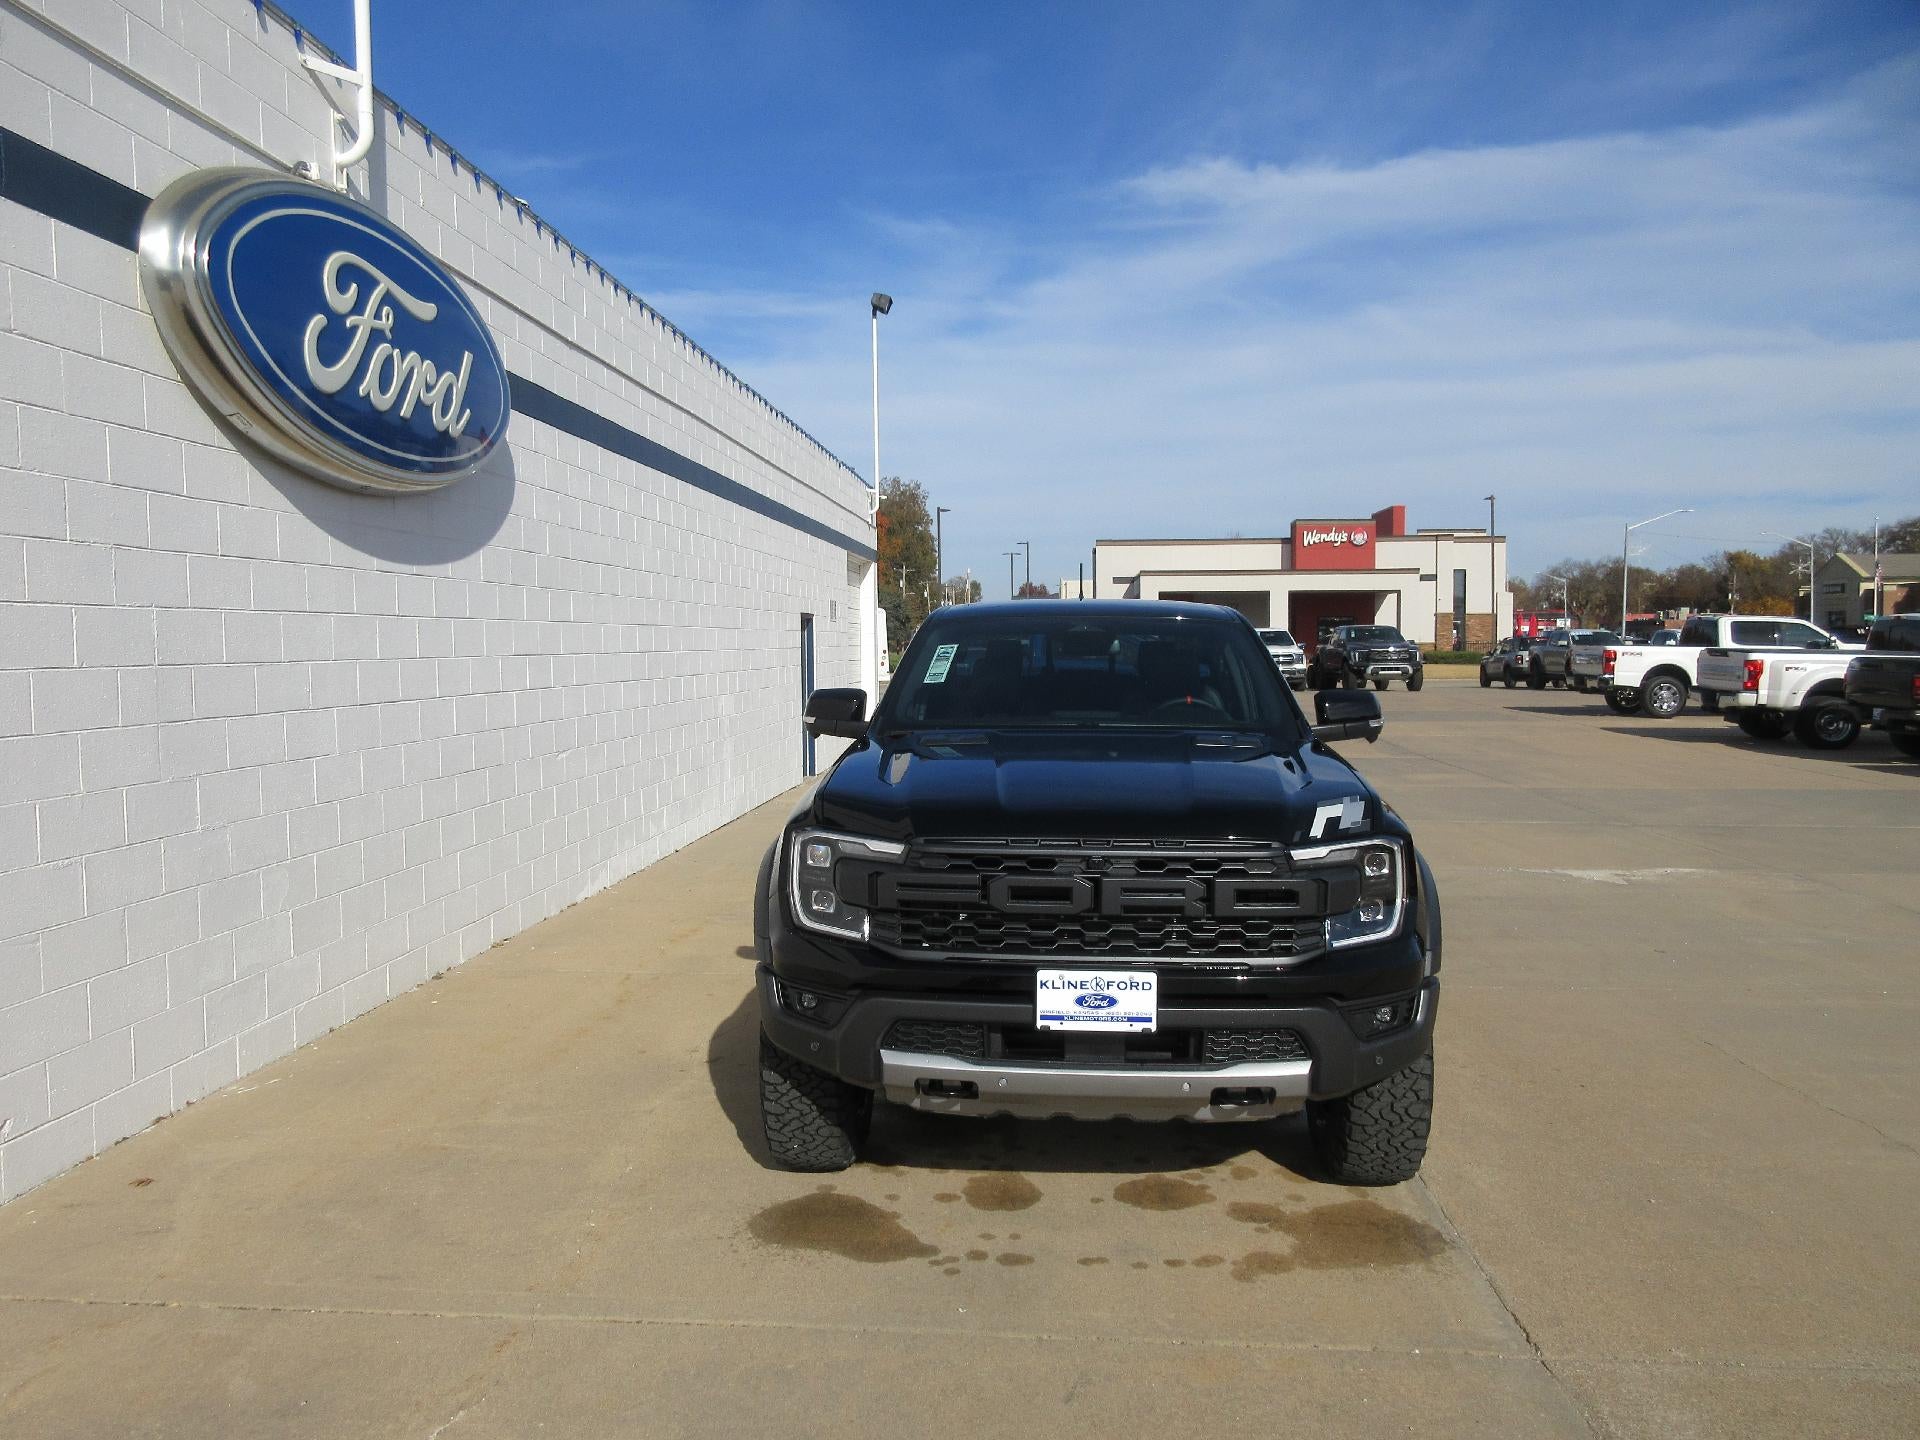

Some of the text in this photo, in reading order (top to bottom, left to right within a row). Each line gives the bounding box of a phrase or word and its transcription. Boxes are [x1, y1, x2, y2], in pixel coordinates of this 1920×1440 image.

[304, 251, 474, 439] Ford
[1303, 527, 1348, 547] Wendy's
[875, 871, 1327, 917] FORD
[1040, 980, 1089, 990] KLINE
[1107, 981, 1152, 991] FORD
[1083, 995, 1110, 1007] Ford
